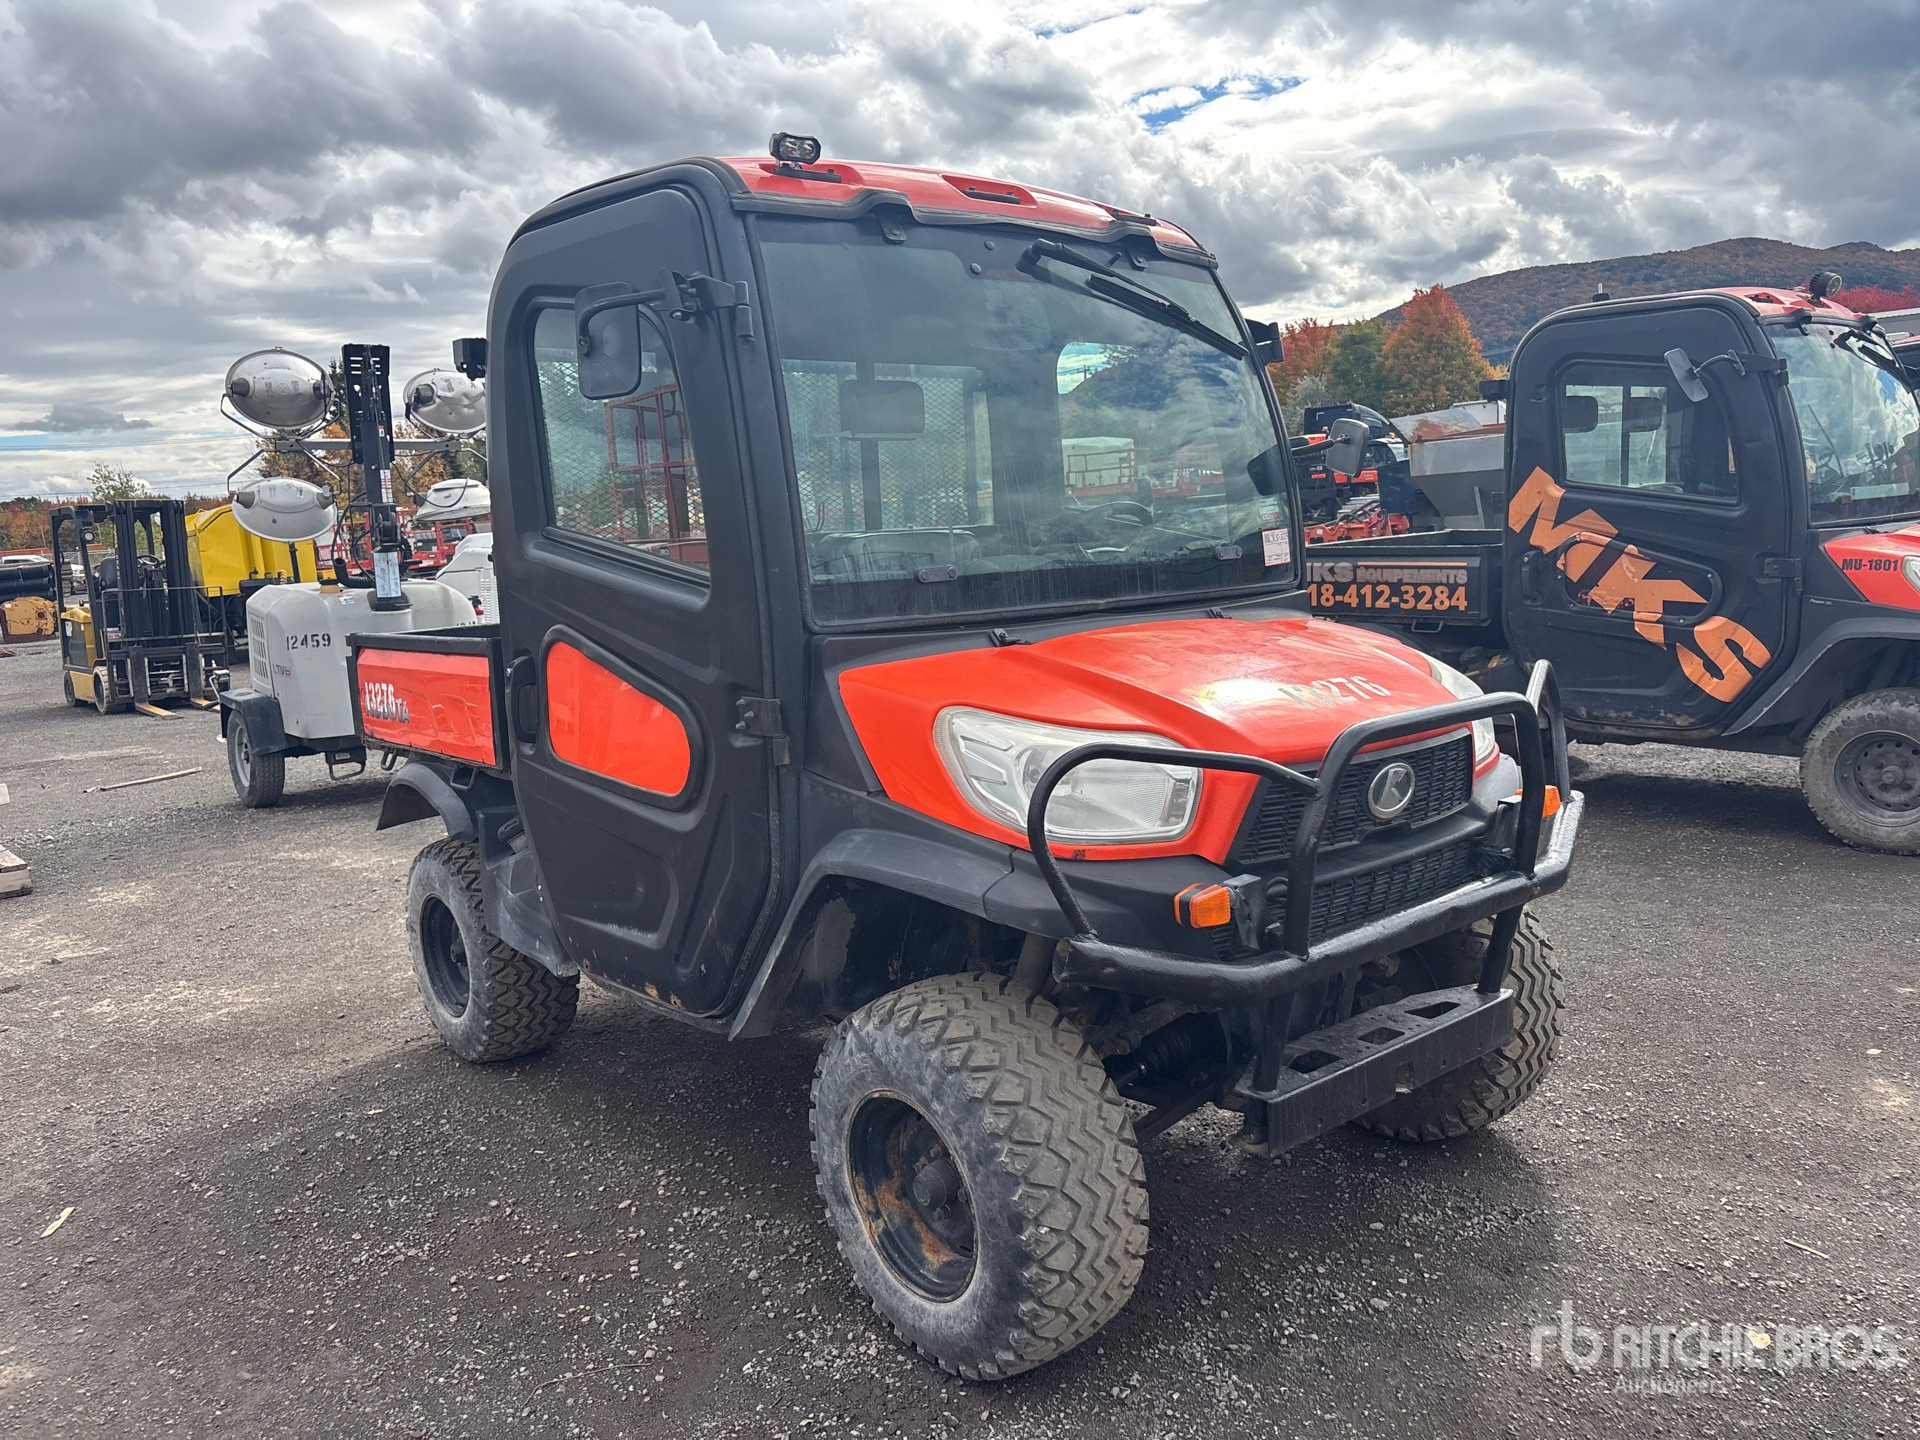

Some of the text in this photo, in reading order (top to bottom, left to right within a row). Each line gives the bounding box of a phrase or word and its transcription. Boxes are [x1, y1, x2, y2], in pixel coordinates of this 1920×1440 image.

[1306, 561, 1354, 583] IKS
[1842, 558, 1899, 572] MU-1801
[1508, 465, 1772, 703] MIKS
[1307, 583, 1468, 612] 18-412-3284
[286, 633, 332, 651] 12459
